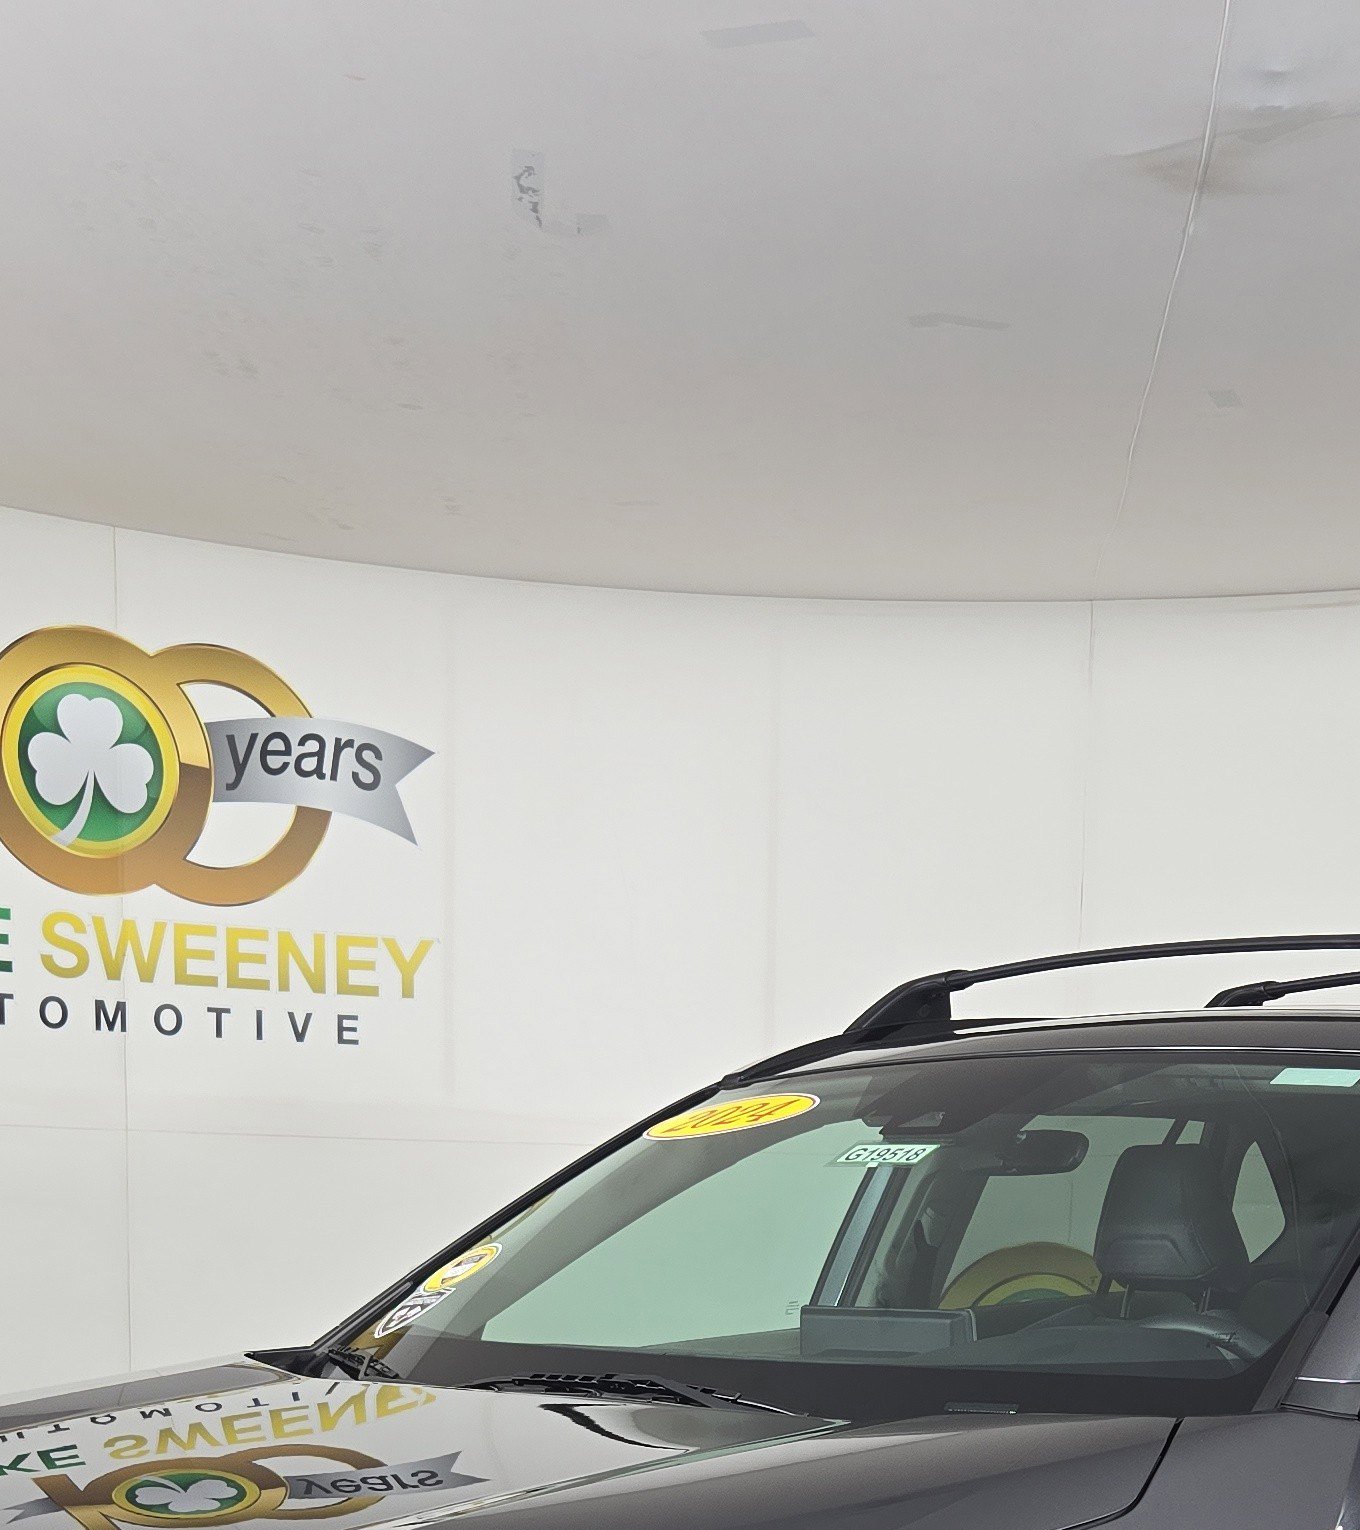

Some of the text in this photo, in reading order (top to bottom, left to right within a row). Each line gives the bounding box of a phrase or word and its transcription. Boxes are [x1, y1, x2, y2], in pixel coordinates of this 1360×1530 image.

[225, 730, 384, 792] years
[40, 911, 435, 999] SWEENEY
[661, 1099, 800, 1134] 2024
[844, 1147, 927, 1162] G19518
